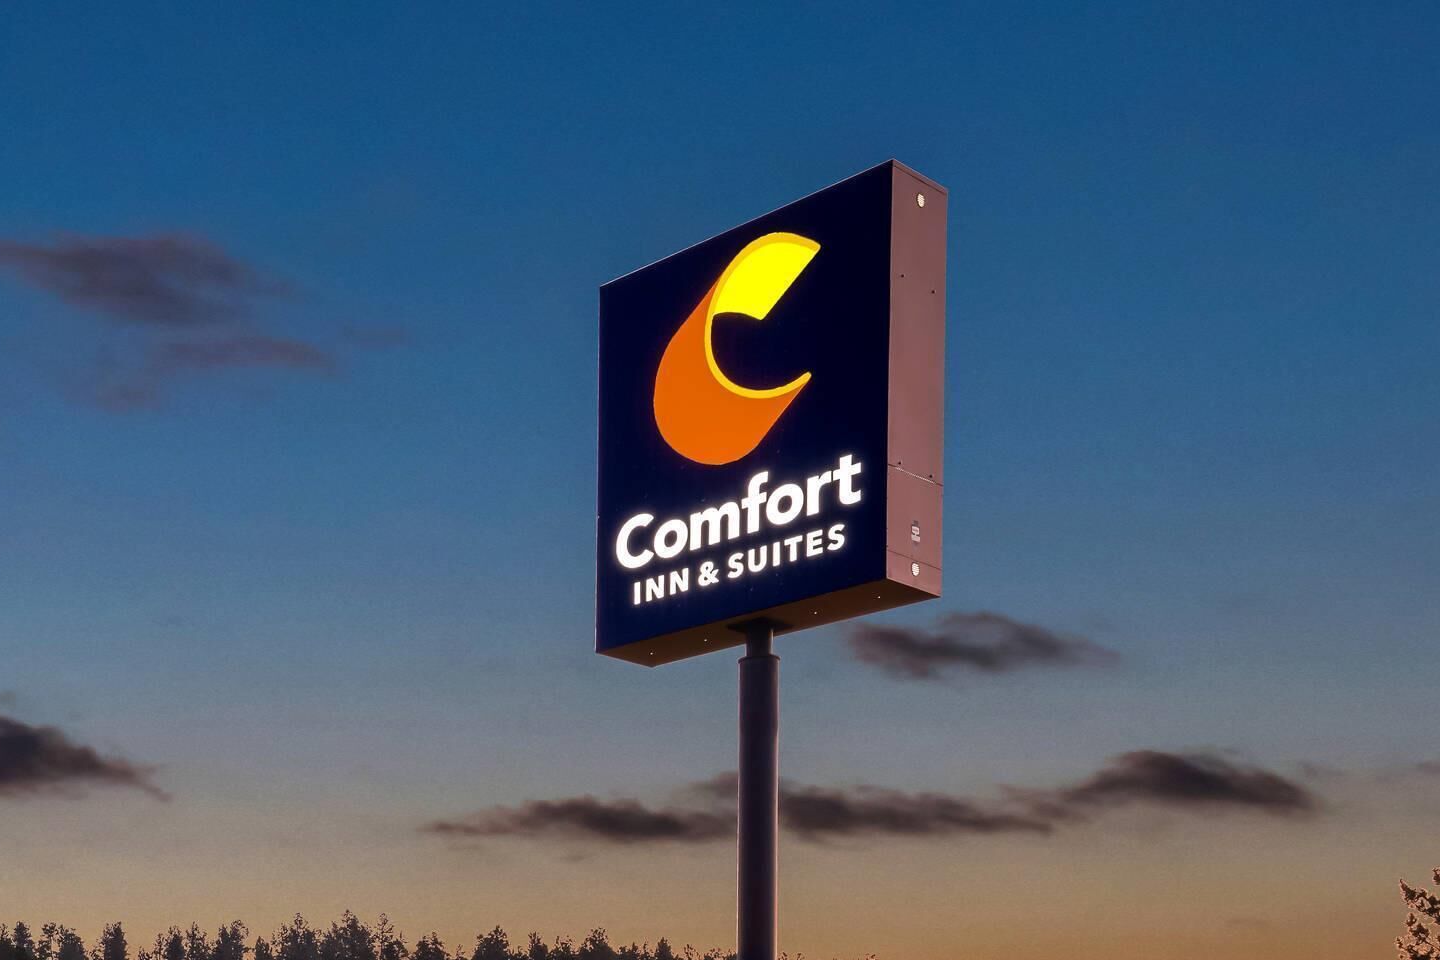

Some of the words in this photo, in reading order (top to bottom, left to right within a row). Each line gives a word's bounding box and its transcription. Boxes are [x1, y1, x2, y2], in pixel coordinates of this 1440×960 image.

[616, 454, 861, 568] Comfort
[633, 568, 689, 605] INN
[698, 560, 720, 586] &
[728, 523, 846, 580] SUITES
